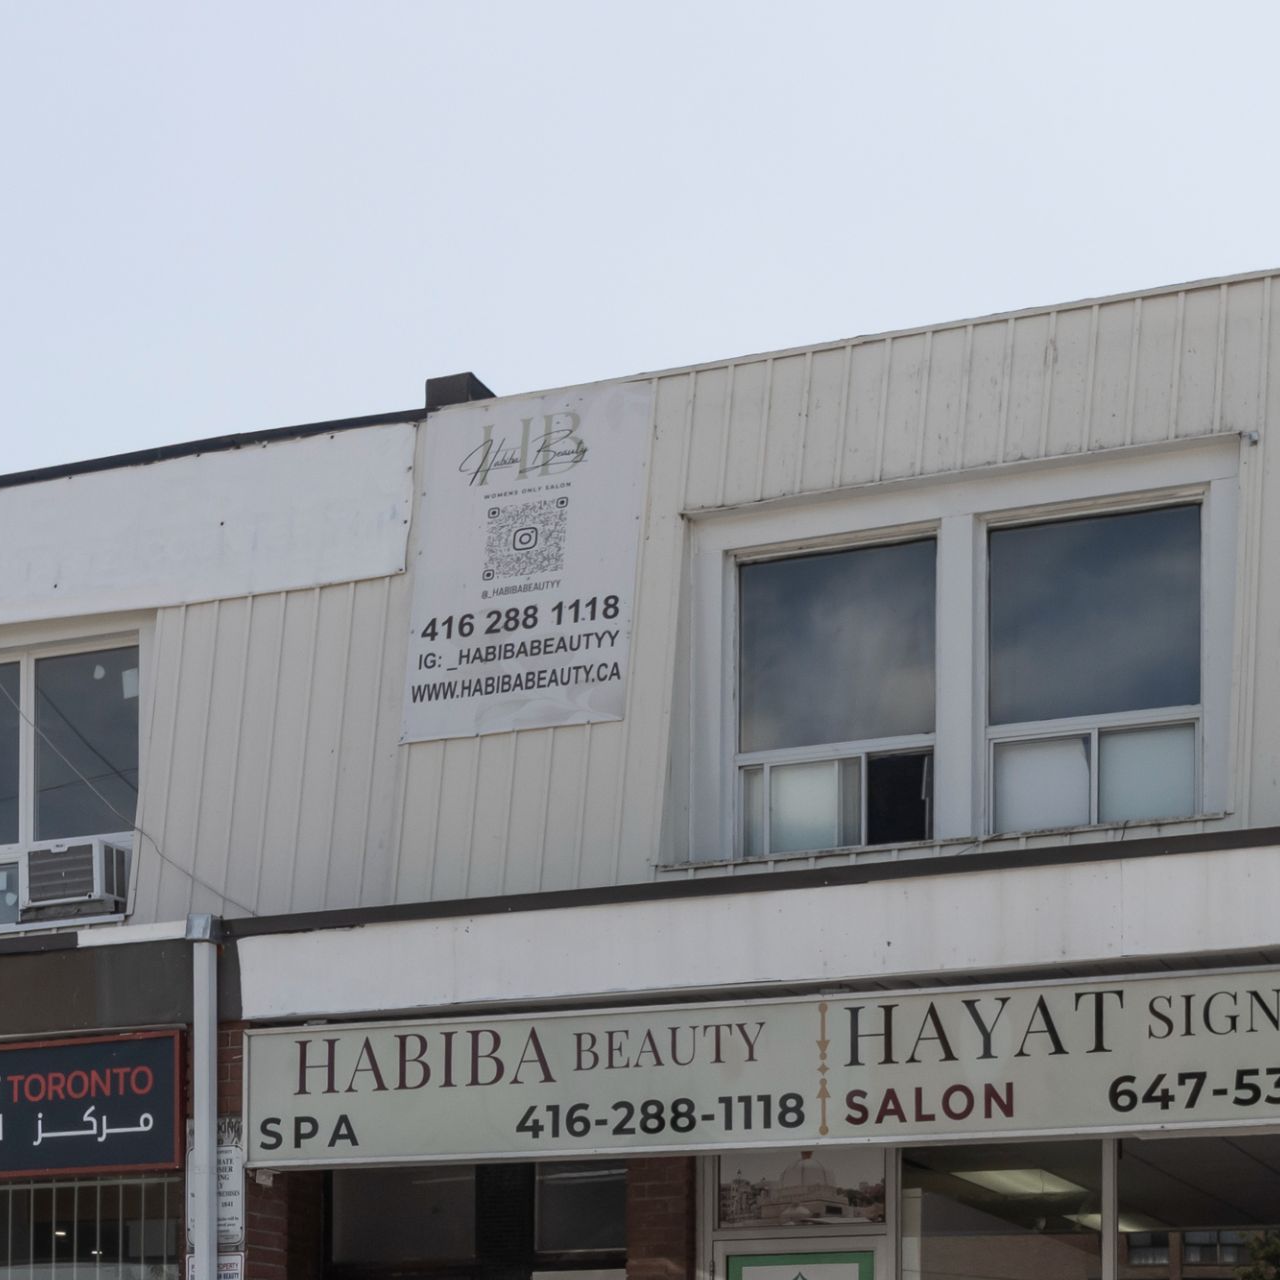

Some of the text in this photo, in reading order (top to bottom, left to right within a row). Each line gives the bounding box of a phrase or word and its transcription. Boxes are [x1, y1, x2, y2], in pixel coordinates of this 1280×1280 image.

[484, 482, 572, 499] WOMENS ONLY SALON
[421, 595, 620, 642] 416 288 1118
[418, 652, 443, 671] IG:
[411, 662, 621, 703] WWW.HABIBABEAUTY.CA
[843, 988, 1124, 1068] HAYAT
[293, 1020, 767, 1096] HABIBA BEAUTY
[7, 1065, 154, 1104] TORONTO
[843, 1080, 1015, 1127] SALON
[33, 1106, 153, 1146] مركز
[259, 1113, 360, 1151] SPA
[514, 1091, 806, 1139] 416-288-1118
